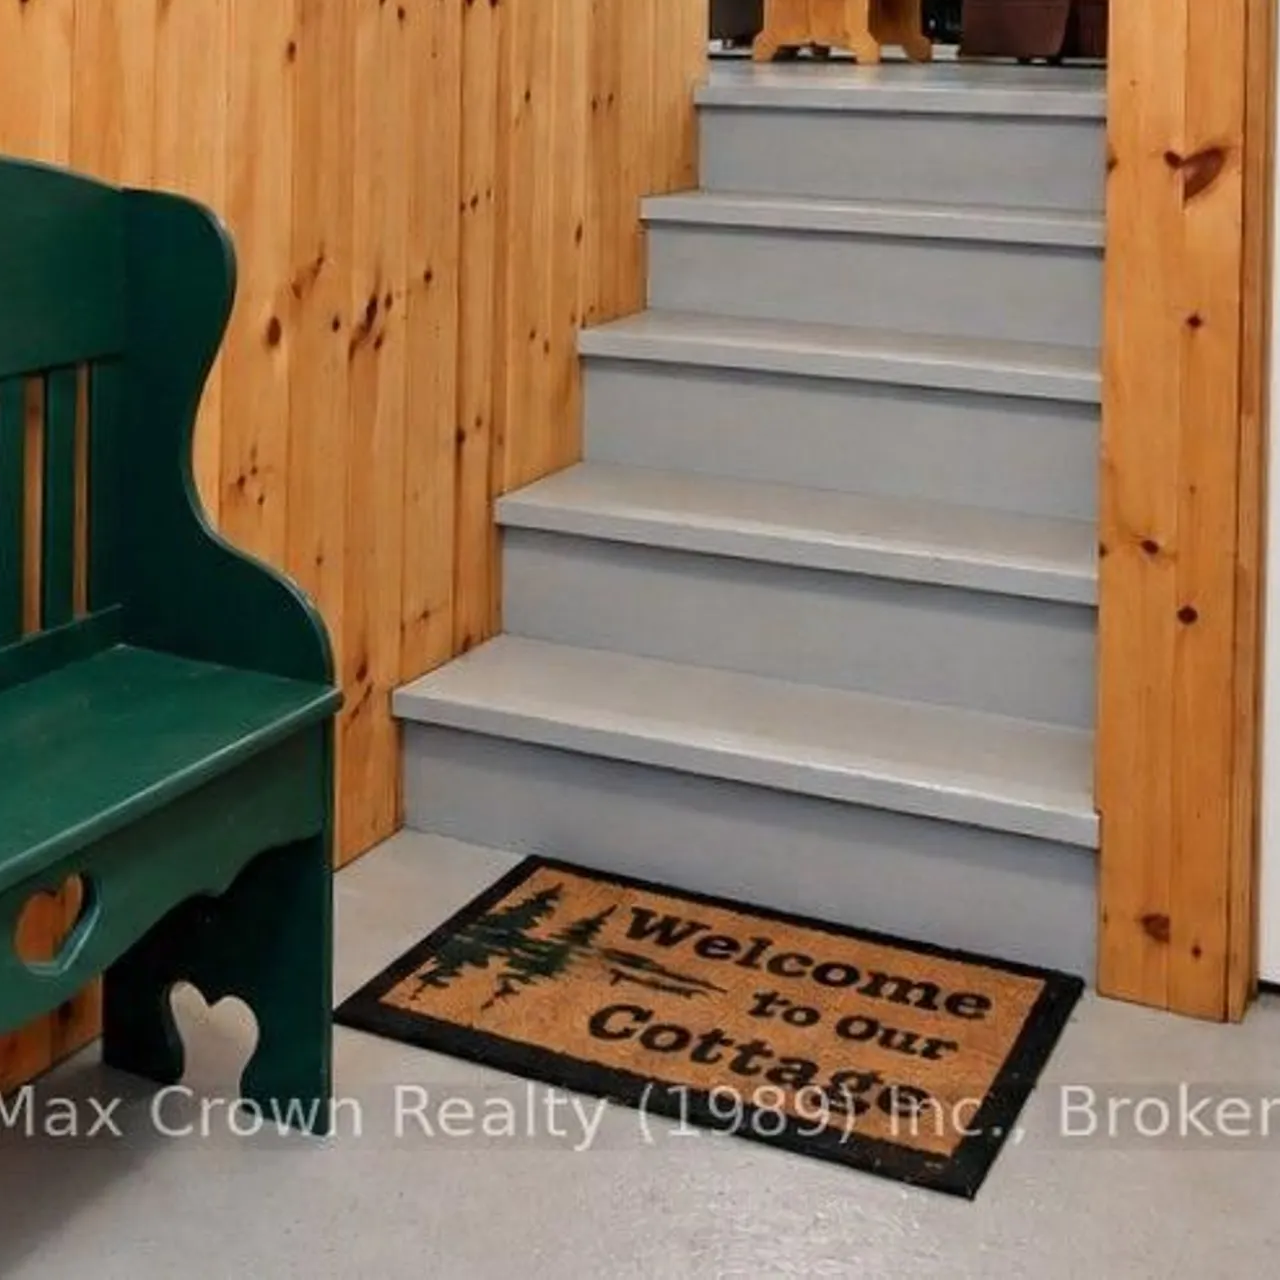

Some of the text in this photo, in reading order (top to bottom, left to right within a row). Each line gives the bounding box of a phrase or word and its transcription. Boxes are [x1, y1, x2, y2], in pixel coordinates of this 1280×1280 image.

[625, 906, 993, 1019] Welcome
[748, 989, 821, 1027] to
[587, 1003, 931, 1117] Cottage
